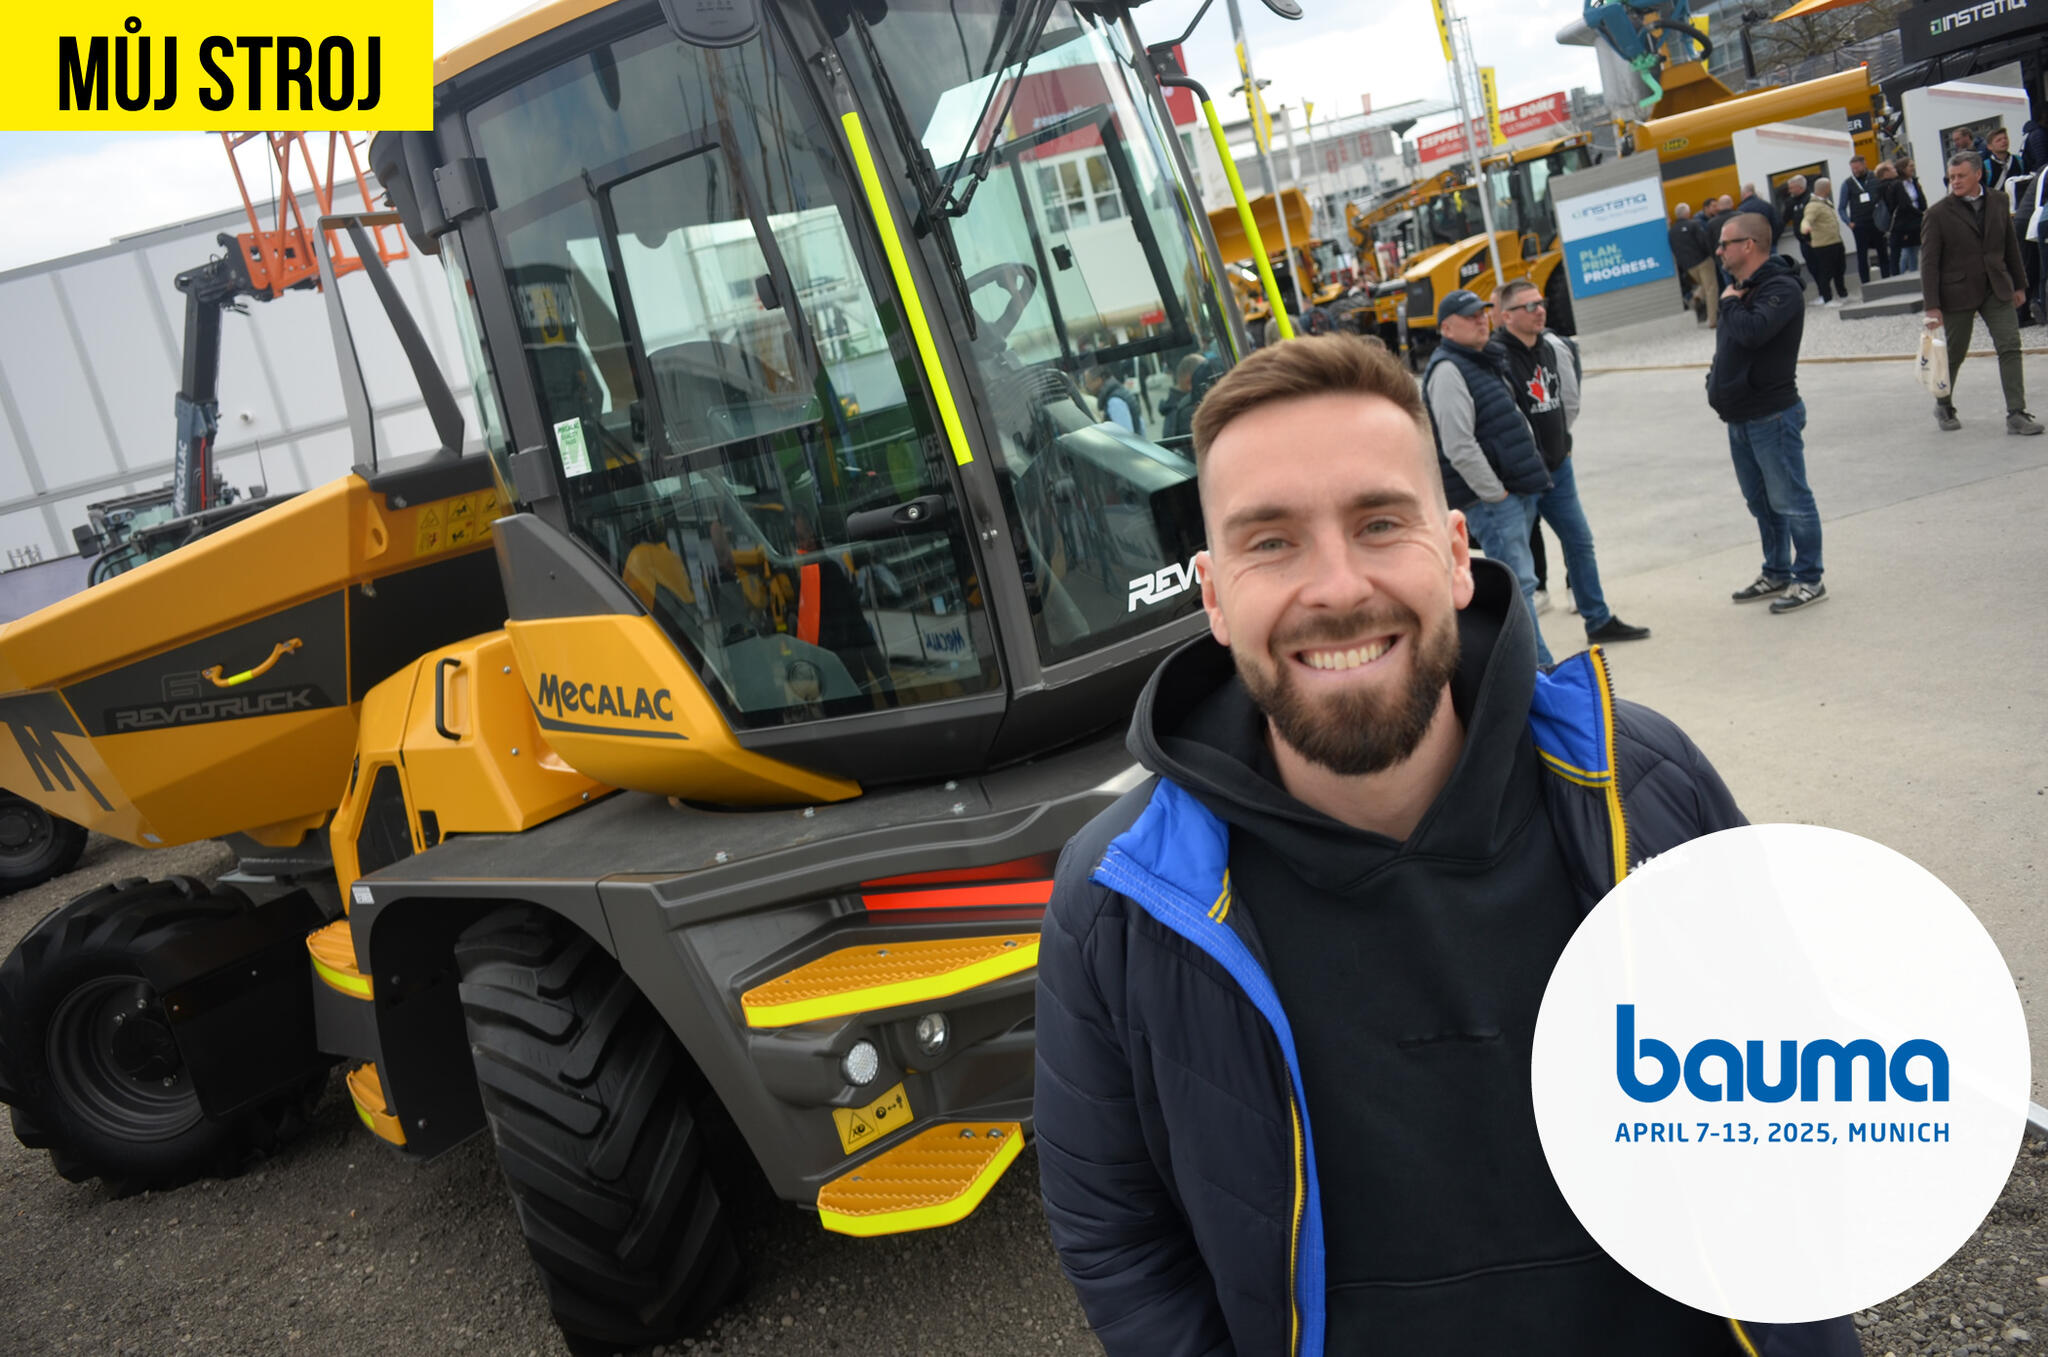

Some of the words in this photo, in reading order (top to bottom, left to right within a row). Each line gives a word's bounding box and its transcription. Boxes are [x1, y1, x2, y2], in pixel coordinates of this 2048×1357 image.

[1421, 125, 1467, 150] ZEPPELI
[1579, 244, 1622, 261] PLAN.
[1581, 254, 1626, 273] PRINT.
[1583, 257, 1660, 284] PROGRESS.
[115, 688, 313, 729] REVOTRUCK
